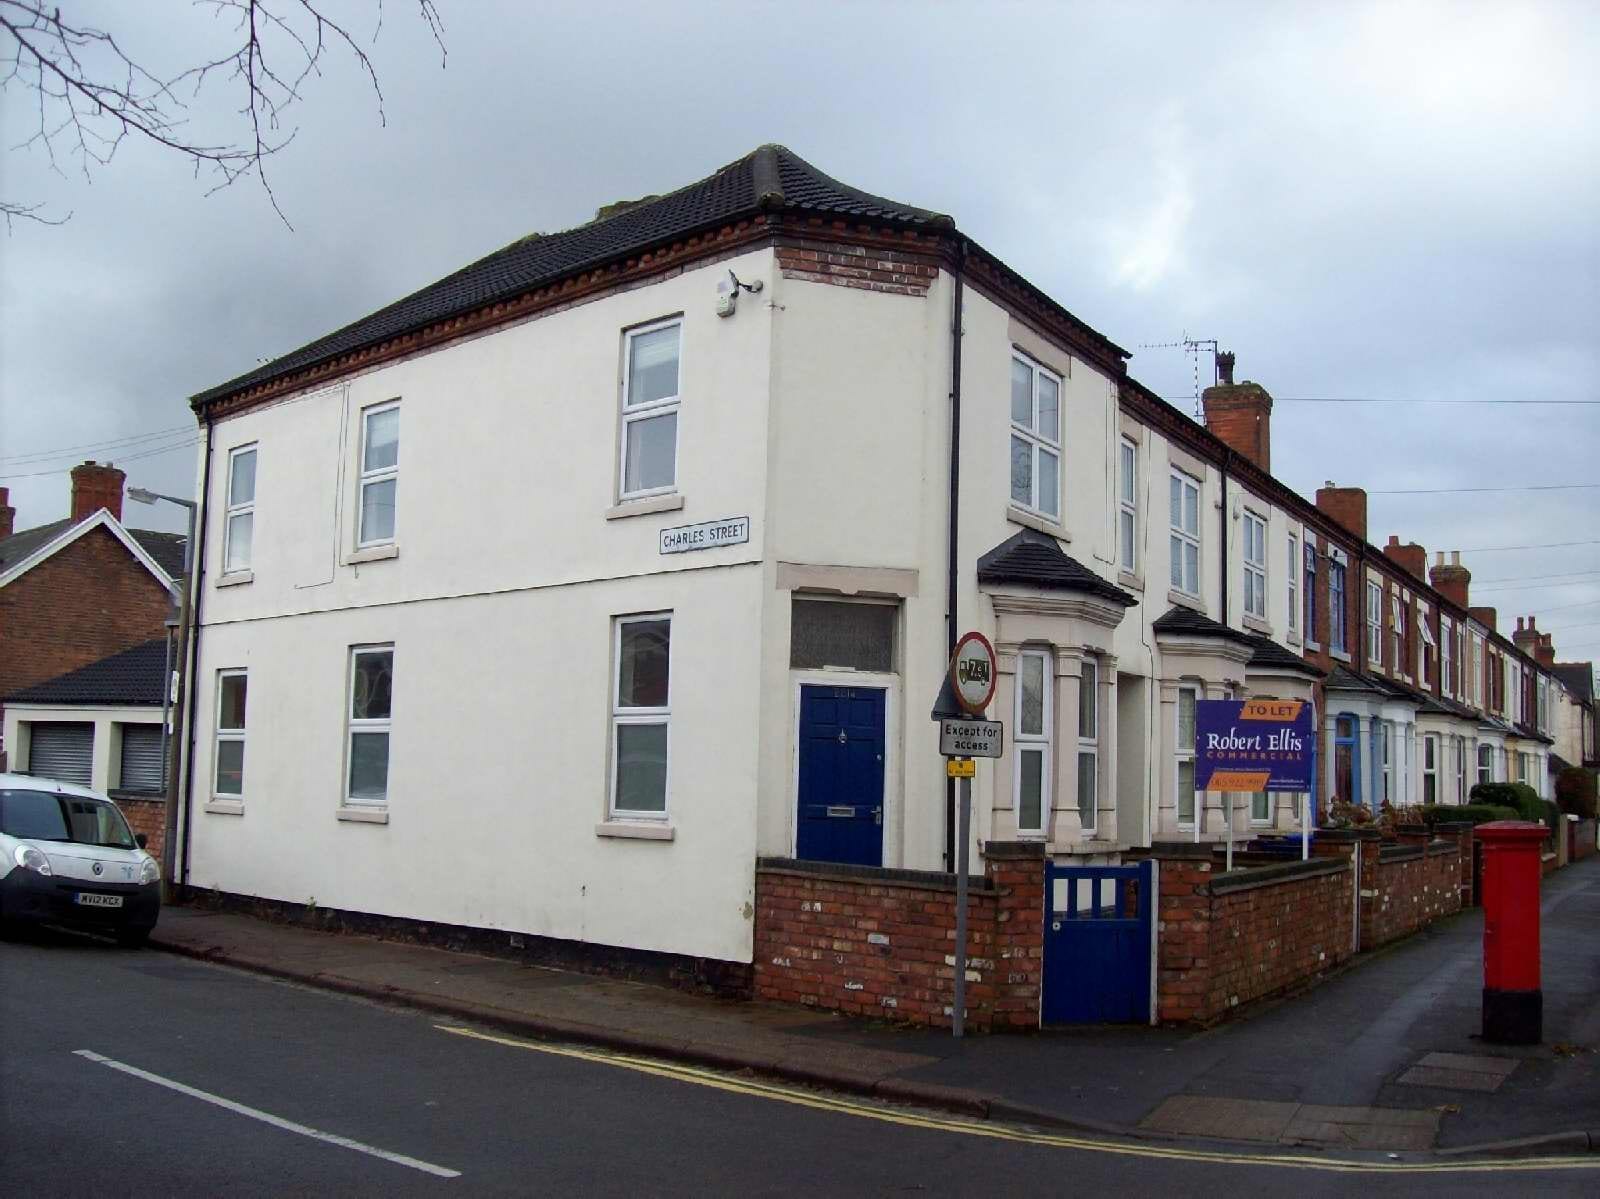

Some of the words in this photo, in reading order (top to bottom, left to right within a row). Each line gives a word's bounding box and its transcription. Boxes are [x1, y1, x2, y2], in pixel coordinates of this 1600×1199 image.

[663, 529, 704, 547] CHARLES
[709, 524, 744, 540] STREET
[1248, 706, 1267, 715] TO
[1271, 707, 1293, 716] LET
[945, 724, 980, 737] Except
[983, 726, 997, 737] for
[1206, 727, 1261, 750] Robert
[1267, 728, 1302, 751] Ellis
[954, 740, 988, 751] access
[1206, 751, 1302, 760] COMMERCIAL
